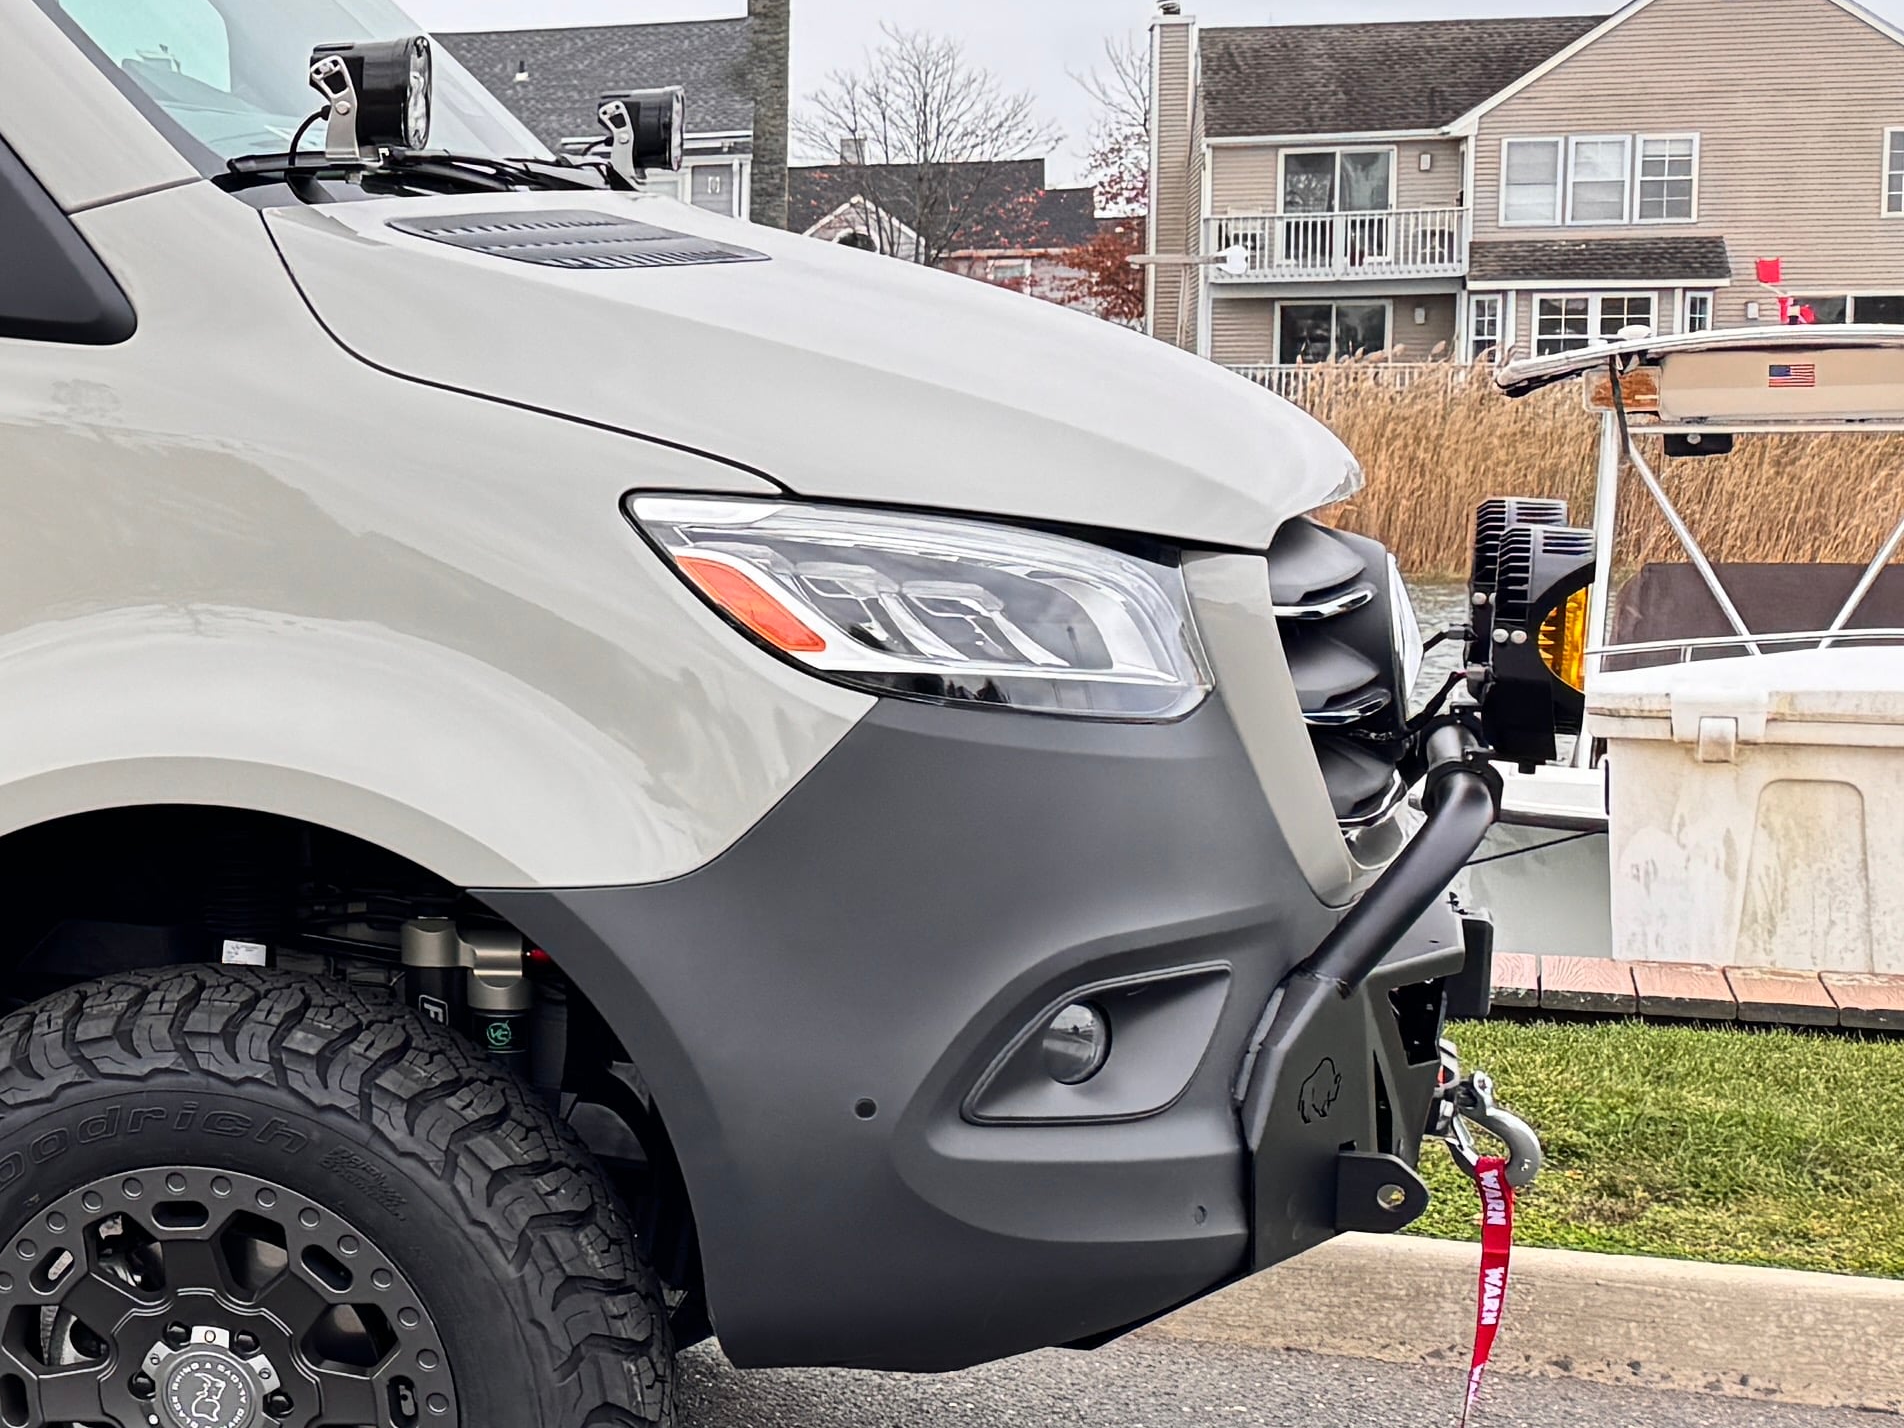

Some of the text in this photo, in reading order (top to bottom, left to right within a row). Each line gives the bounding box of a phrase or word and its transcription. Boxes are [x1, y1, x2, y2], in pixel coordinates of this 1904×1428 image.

[1479, 1169, 1506, 1226] WARN
[1481, 1266, 1505, 1326] WARN
[171, 1362, 200, 1391] RHINO
